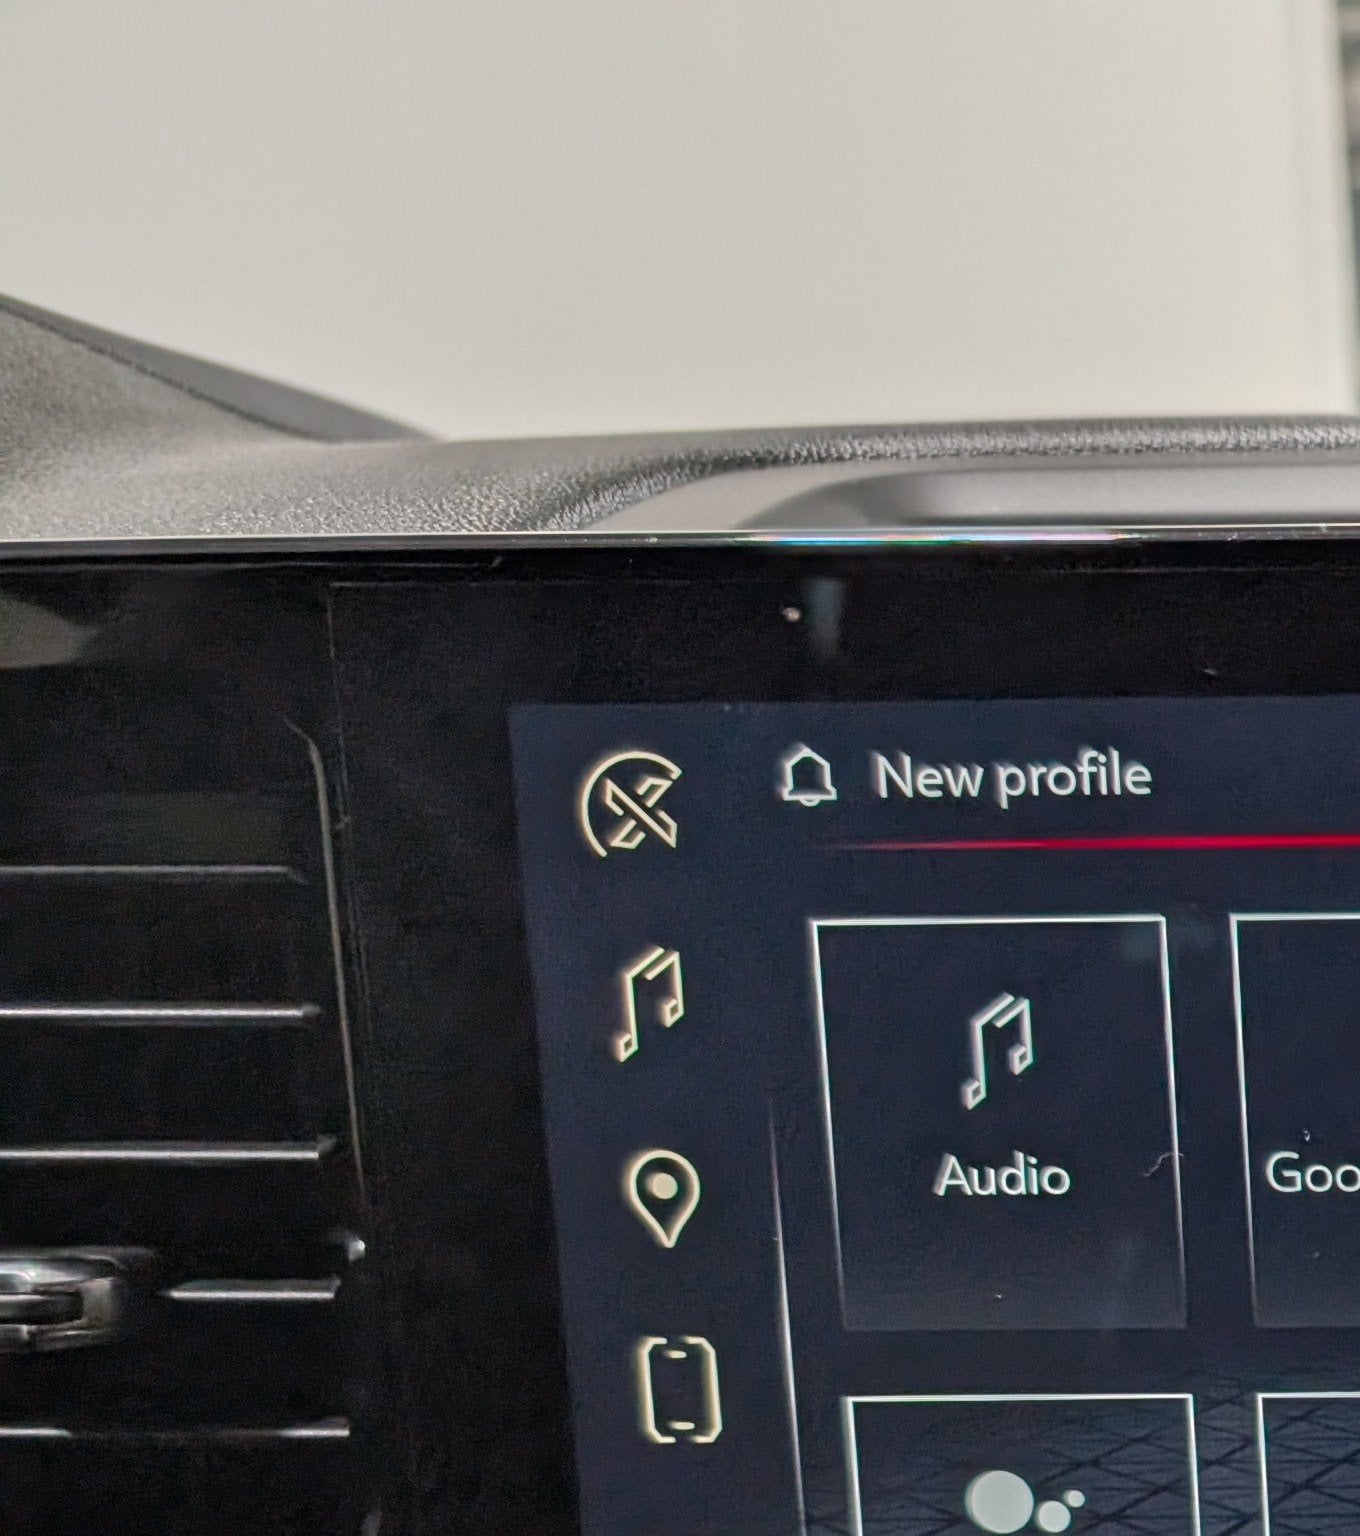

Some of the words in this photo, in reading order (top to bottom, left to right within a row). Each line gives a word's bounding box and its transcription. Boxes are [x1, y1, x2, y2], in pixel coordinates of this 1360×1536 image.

[874, 752, 985, 799] New
[995, 748, 1152, 810] profile
[935, 1150, 1071, 1197] Audio
